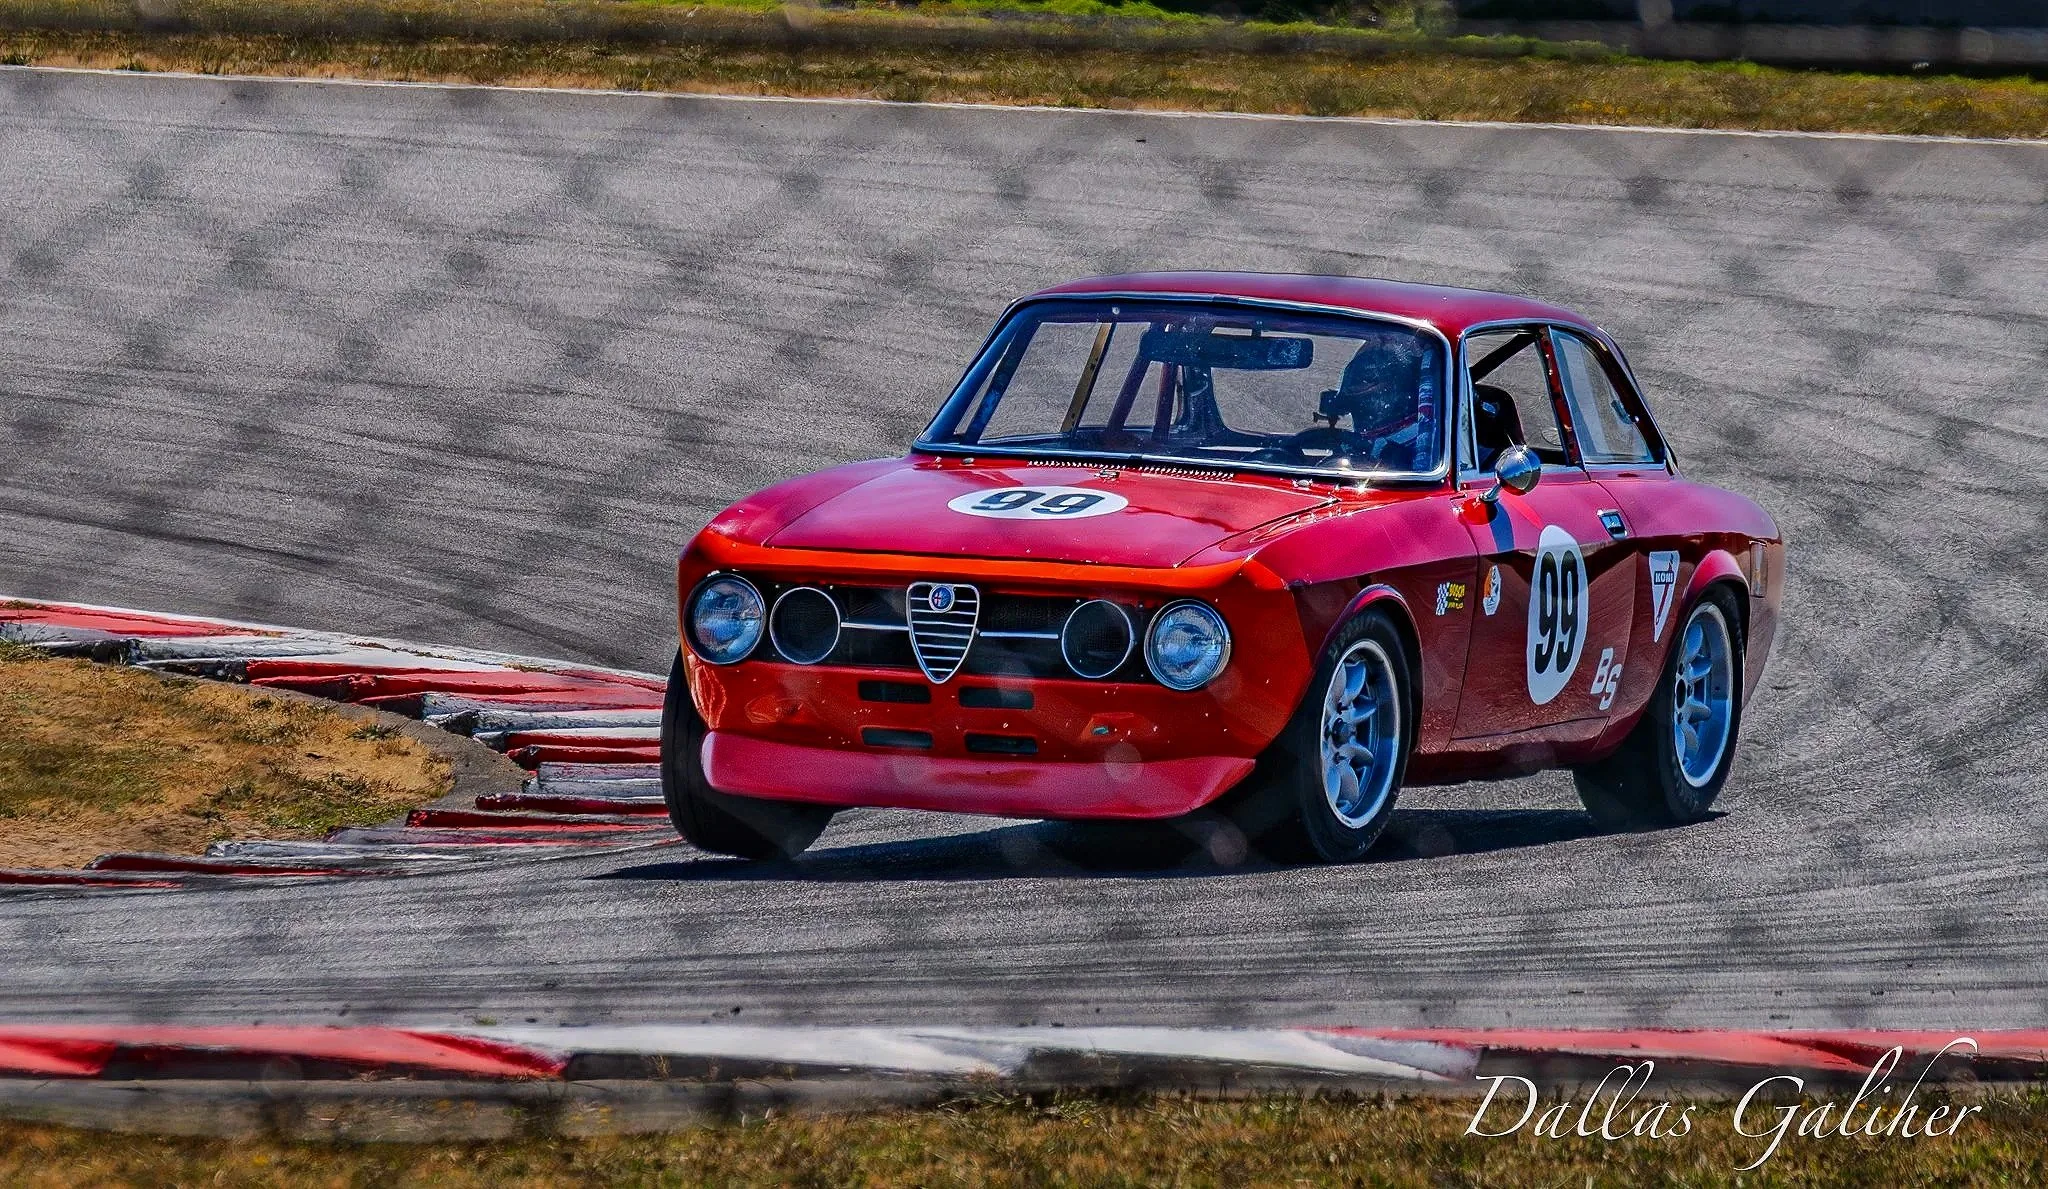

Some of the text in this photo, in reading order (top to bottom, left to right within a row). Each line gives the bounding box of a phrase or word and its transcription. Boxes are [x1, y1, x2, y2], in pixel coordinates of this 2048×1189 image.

[971, 490, 1106, 515] 99
[1655, 572, 1674, 583] KONI
[1534, 550, 1579, 674] 99
